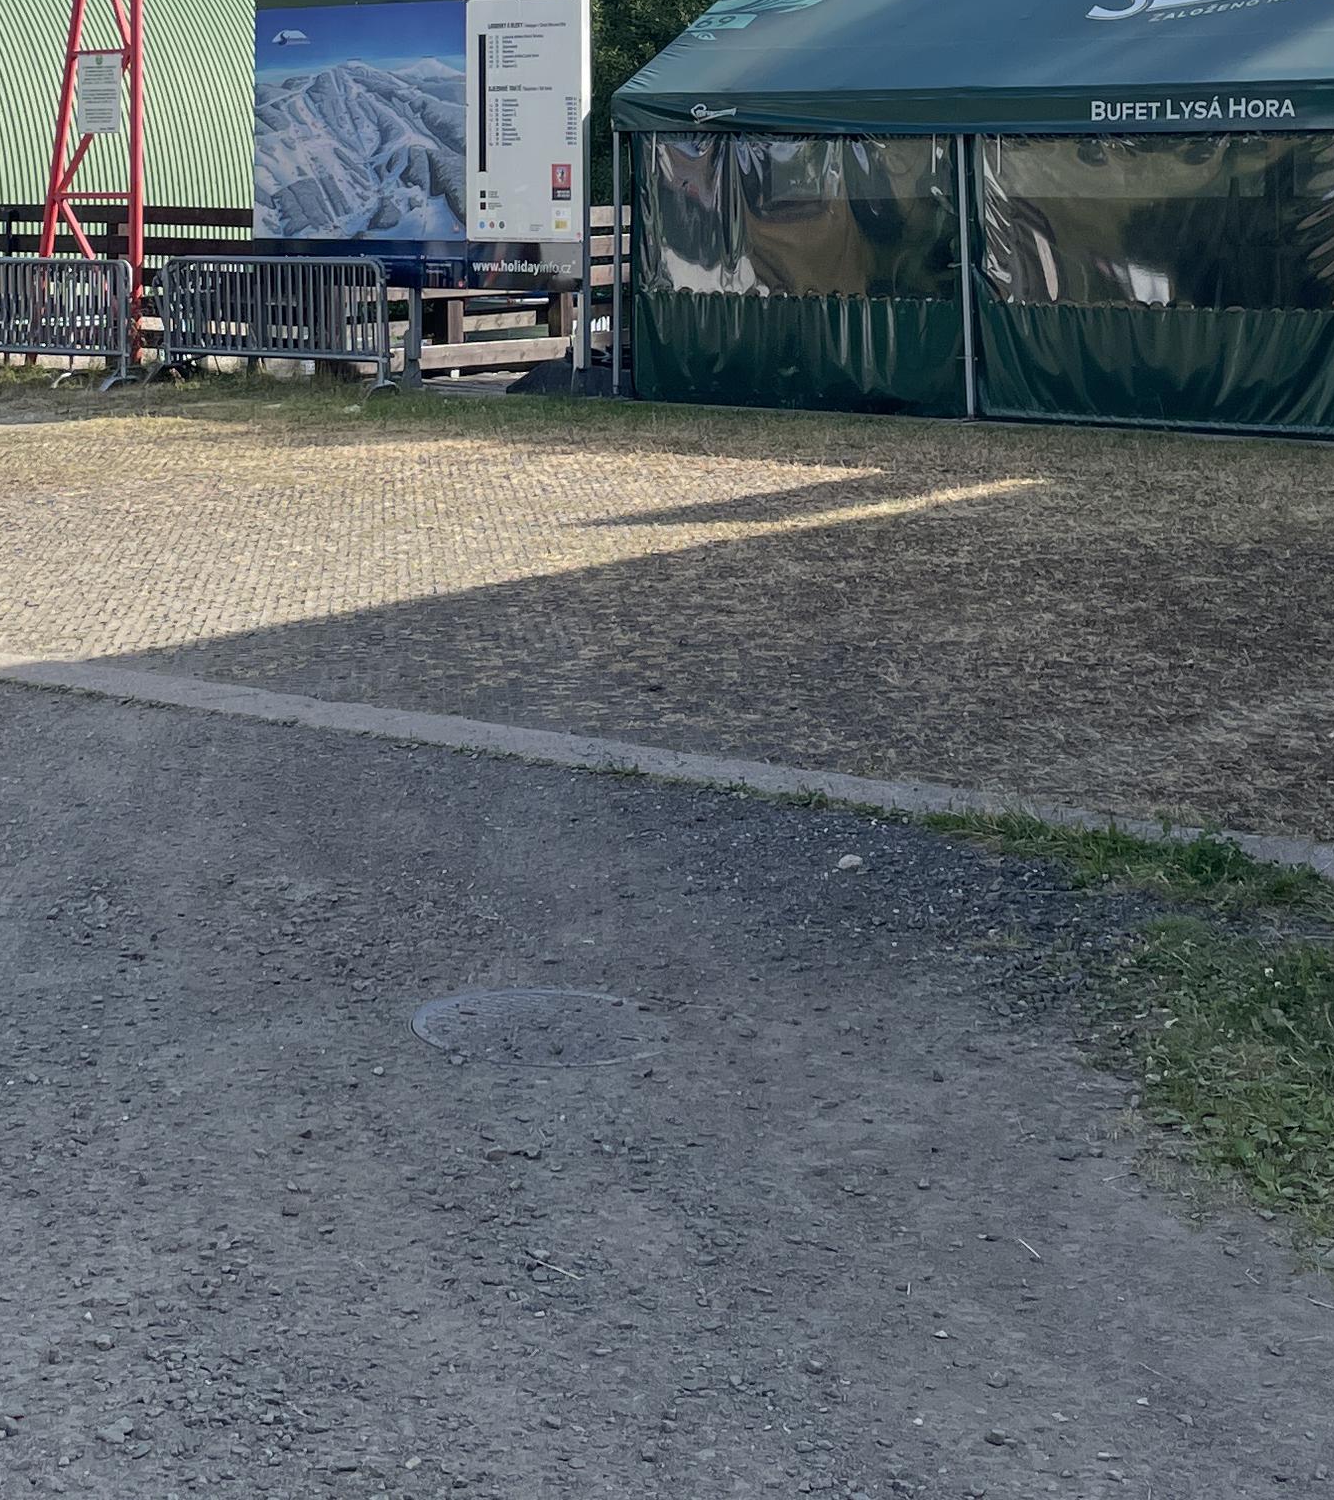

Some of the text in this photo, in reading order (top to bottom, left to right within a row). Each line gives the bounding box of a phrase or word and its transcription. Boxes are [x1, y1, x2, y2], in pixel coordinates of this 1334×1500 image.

[1091, 95, 1296, 121] BUFET LYSÁ HORA
[472, 259, 572, 275] www.holidayinfo.cz
